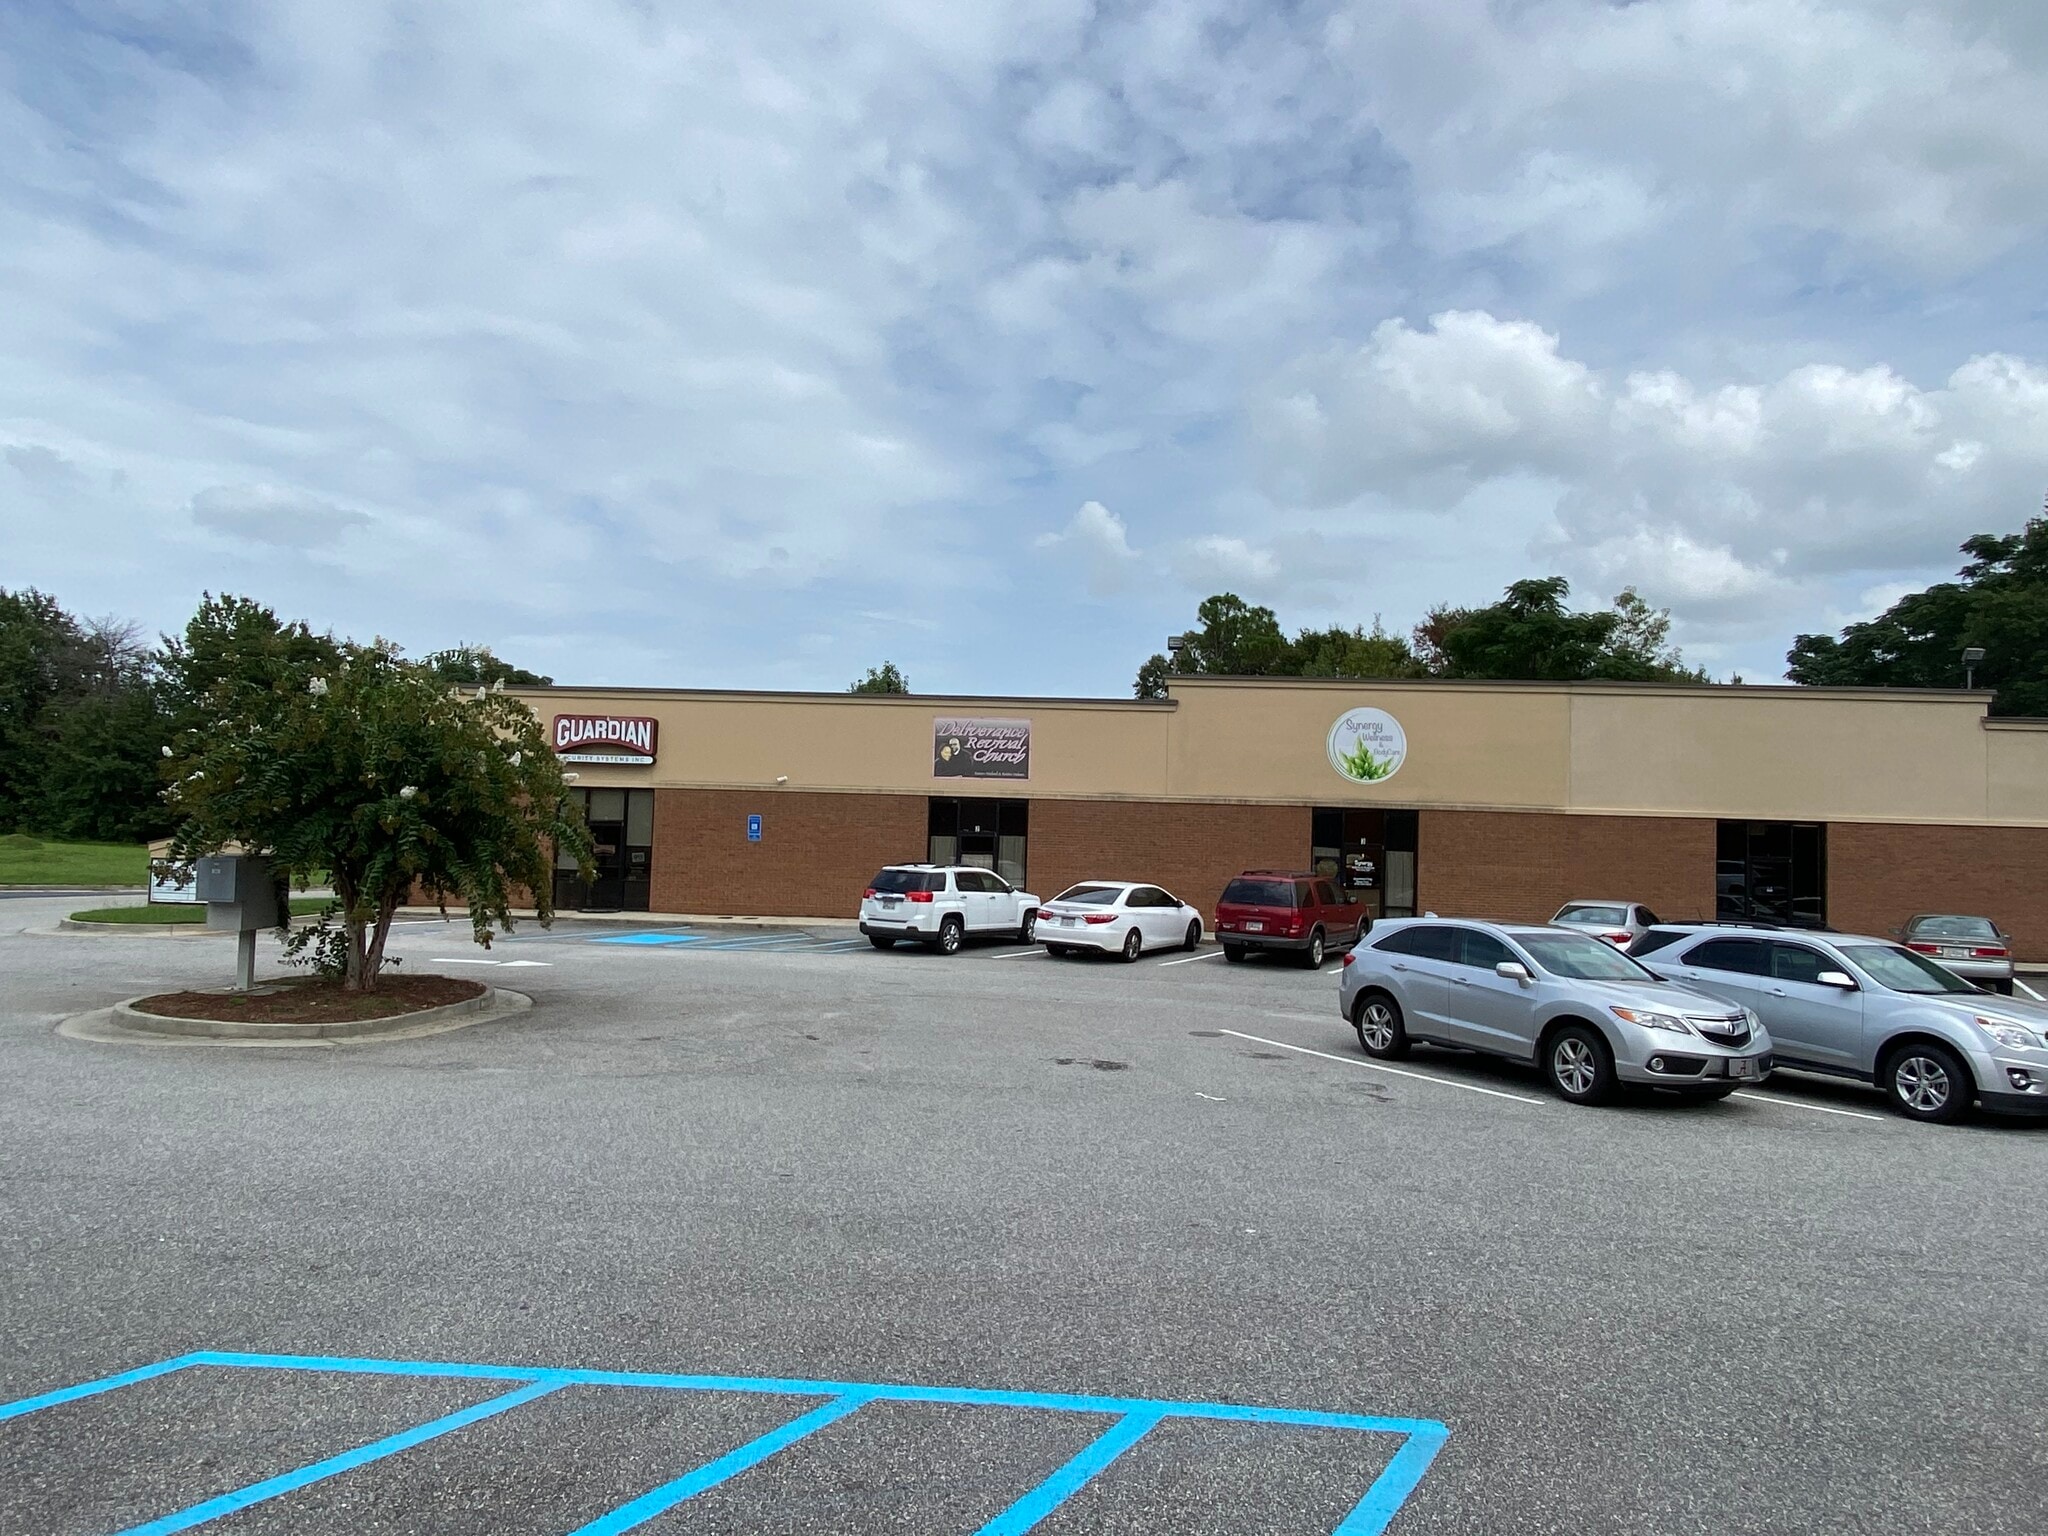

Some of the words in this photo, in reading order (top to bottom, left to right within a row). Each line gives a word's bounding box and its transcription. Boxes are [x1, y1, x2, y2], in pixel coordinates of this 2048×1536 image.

[937, 720, 1025, 739] Deliverance
[1346, 718, 1383, 733] Synergy
[556, 719, 651, 751] GUARDIAN
[964, 734, 1028, 750] Revival
[1362, 733, 1393, 741] Wellness
[973, 746, 1026, 765] Church
